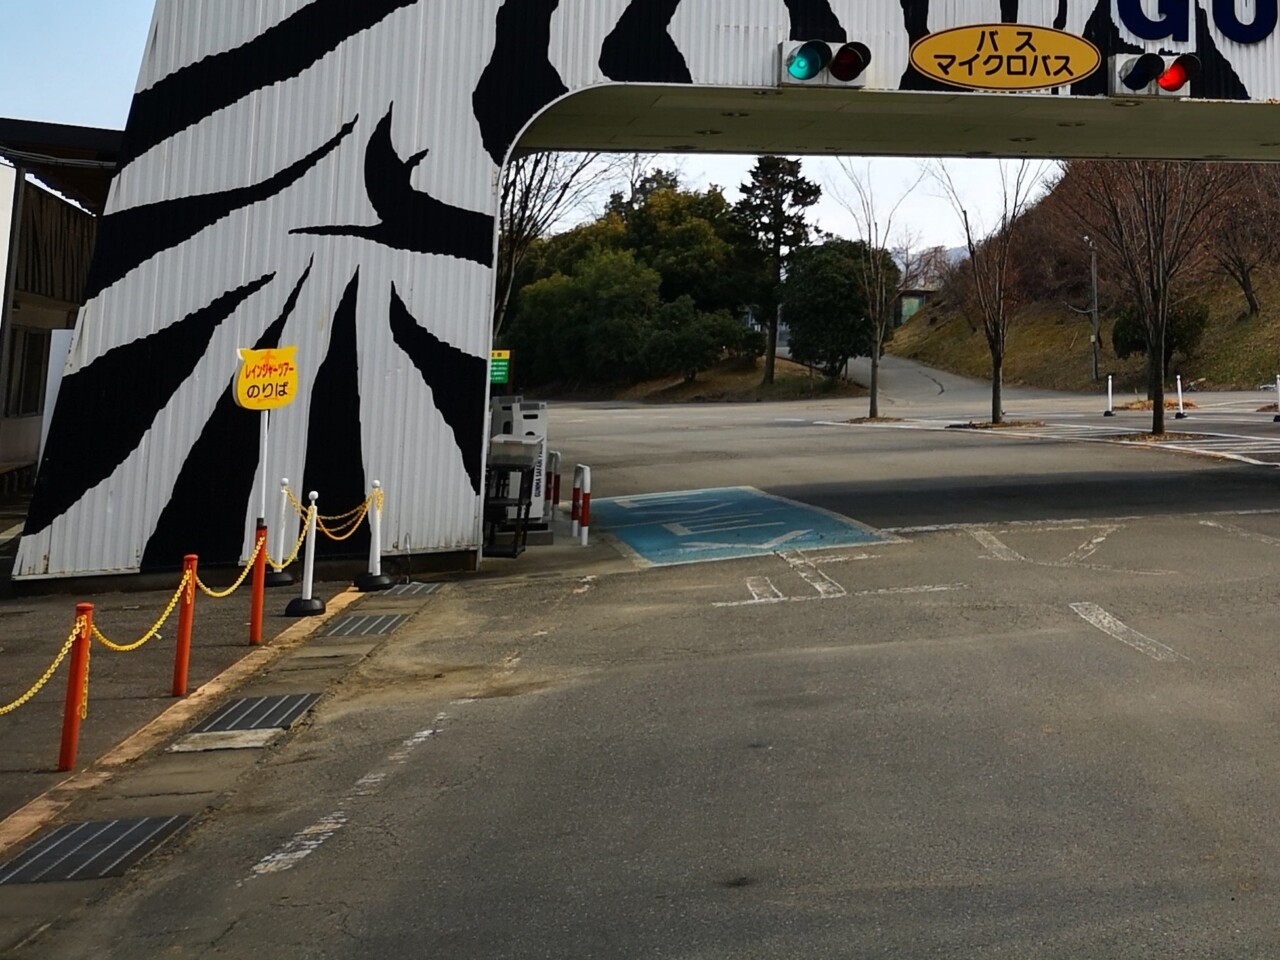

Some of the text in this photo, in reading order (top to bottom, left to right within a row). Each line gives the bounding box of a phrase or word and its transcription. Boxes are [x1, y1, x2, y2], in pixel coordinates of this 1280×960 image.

[976, 29, 1036, 52] バス
[933, 53, 1074, 77] マイクロバス
[245, 362, 294, 379] レインジャーツアー
[247, 381, 289, 398] のりば
[534, 478, 542, 497] GUNMA
